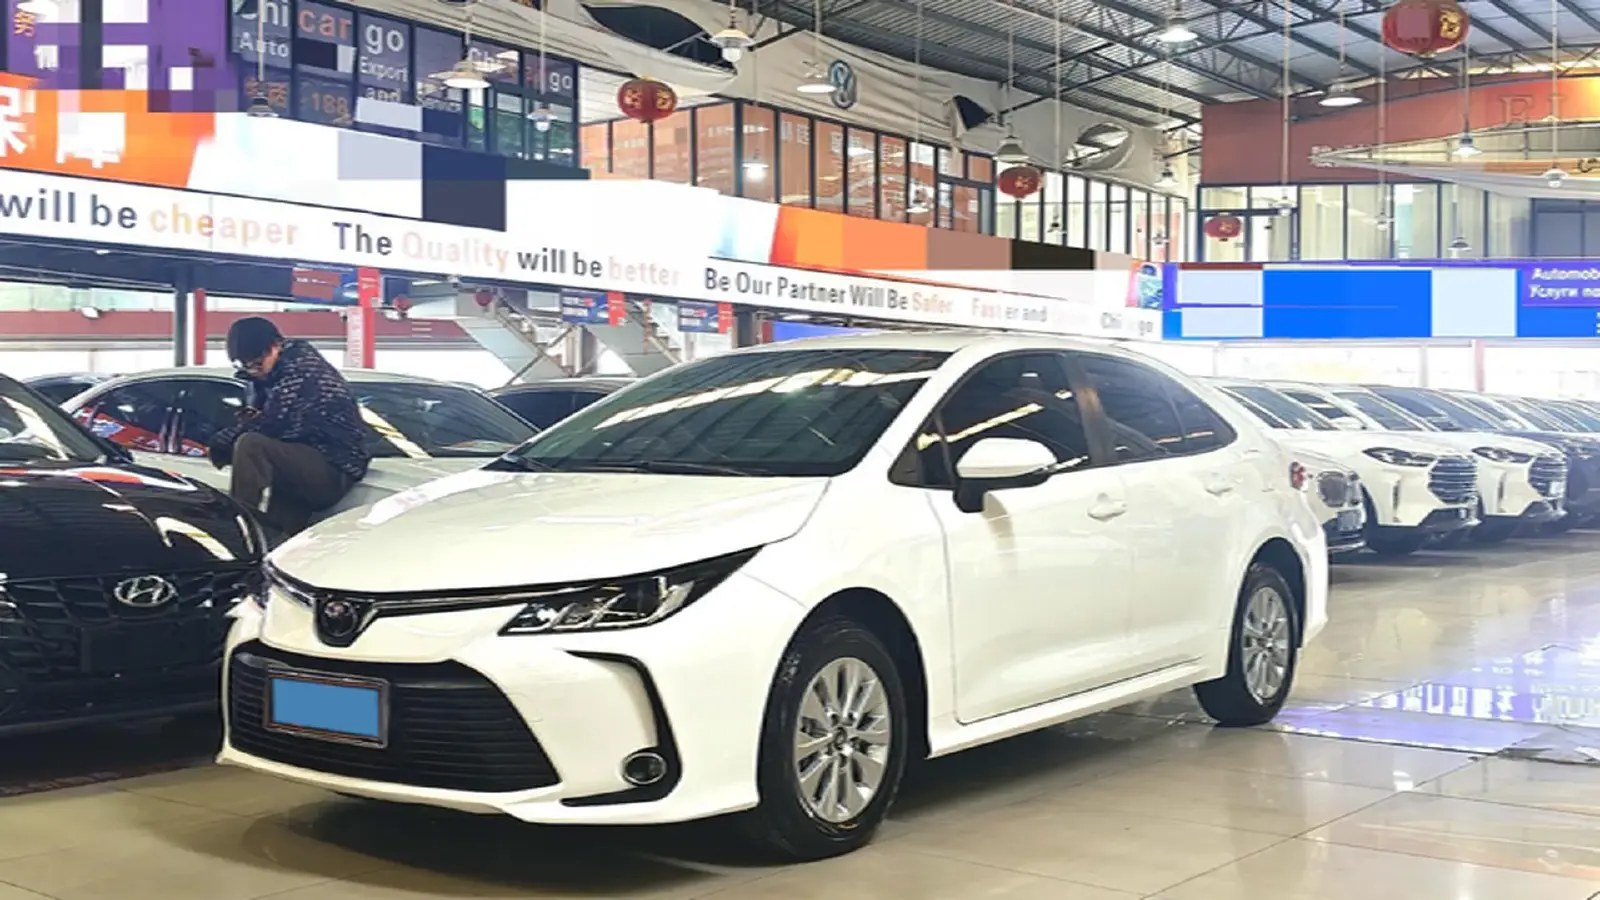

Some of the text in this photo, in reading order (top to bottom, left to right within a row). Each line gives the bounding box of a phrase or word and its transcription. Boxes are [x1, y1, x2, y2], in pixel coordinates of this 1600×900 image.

[297, 9, 352, 39] car
[365, 24, 404, 55] go
[360, 56, 408, 82] Export
[549, 72, 574, 93] go
[0, 188, 76, 224] will
[91, 193, 138, 229] be
[149, 203, 299, 246] cheaper
[332, 222, 393, 256] The
[402, 231, 509, 273] Quality
[517, 247, 567, 274] will
[572, 252, 602, 278] be
[608, 256, 681, 287] better
[705, 267, 730, 292] Be
[736, 271, 773, 295] Our
[777, 276, 846, 304] Partner
[850, 284, 884, 308] Will
[887, 289, 909, 310] Be
[912, 292, 953, 314] Safer
[1528, 284, 1579, 300] Услуги
